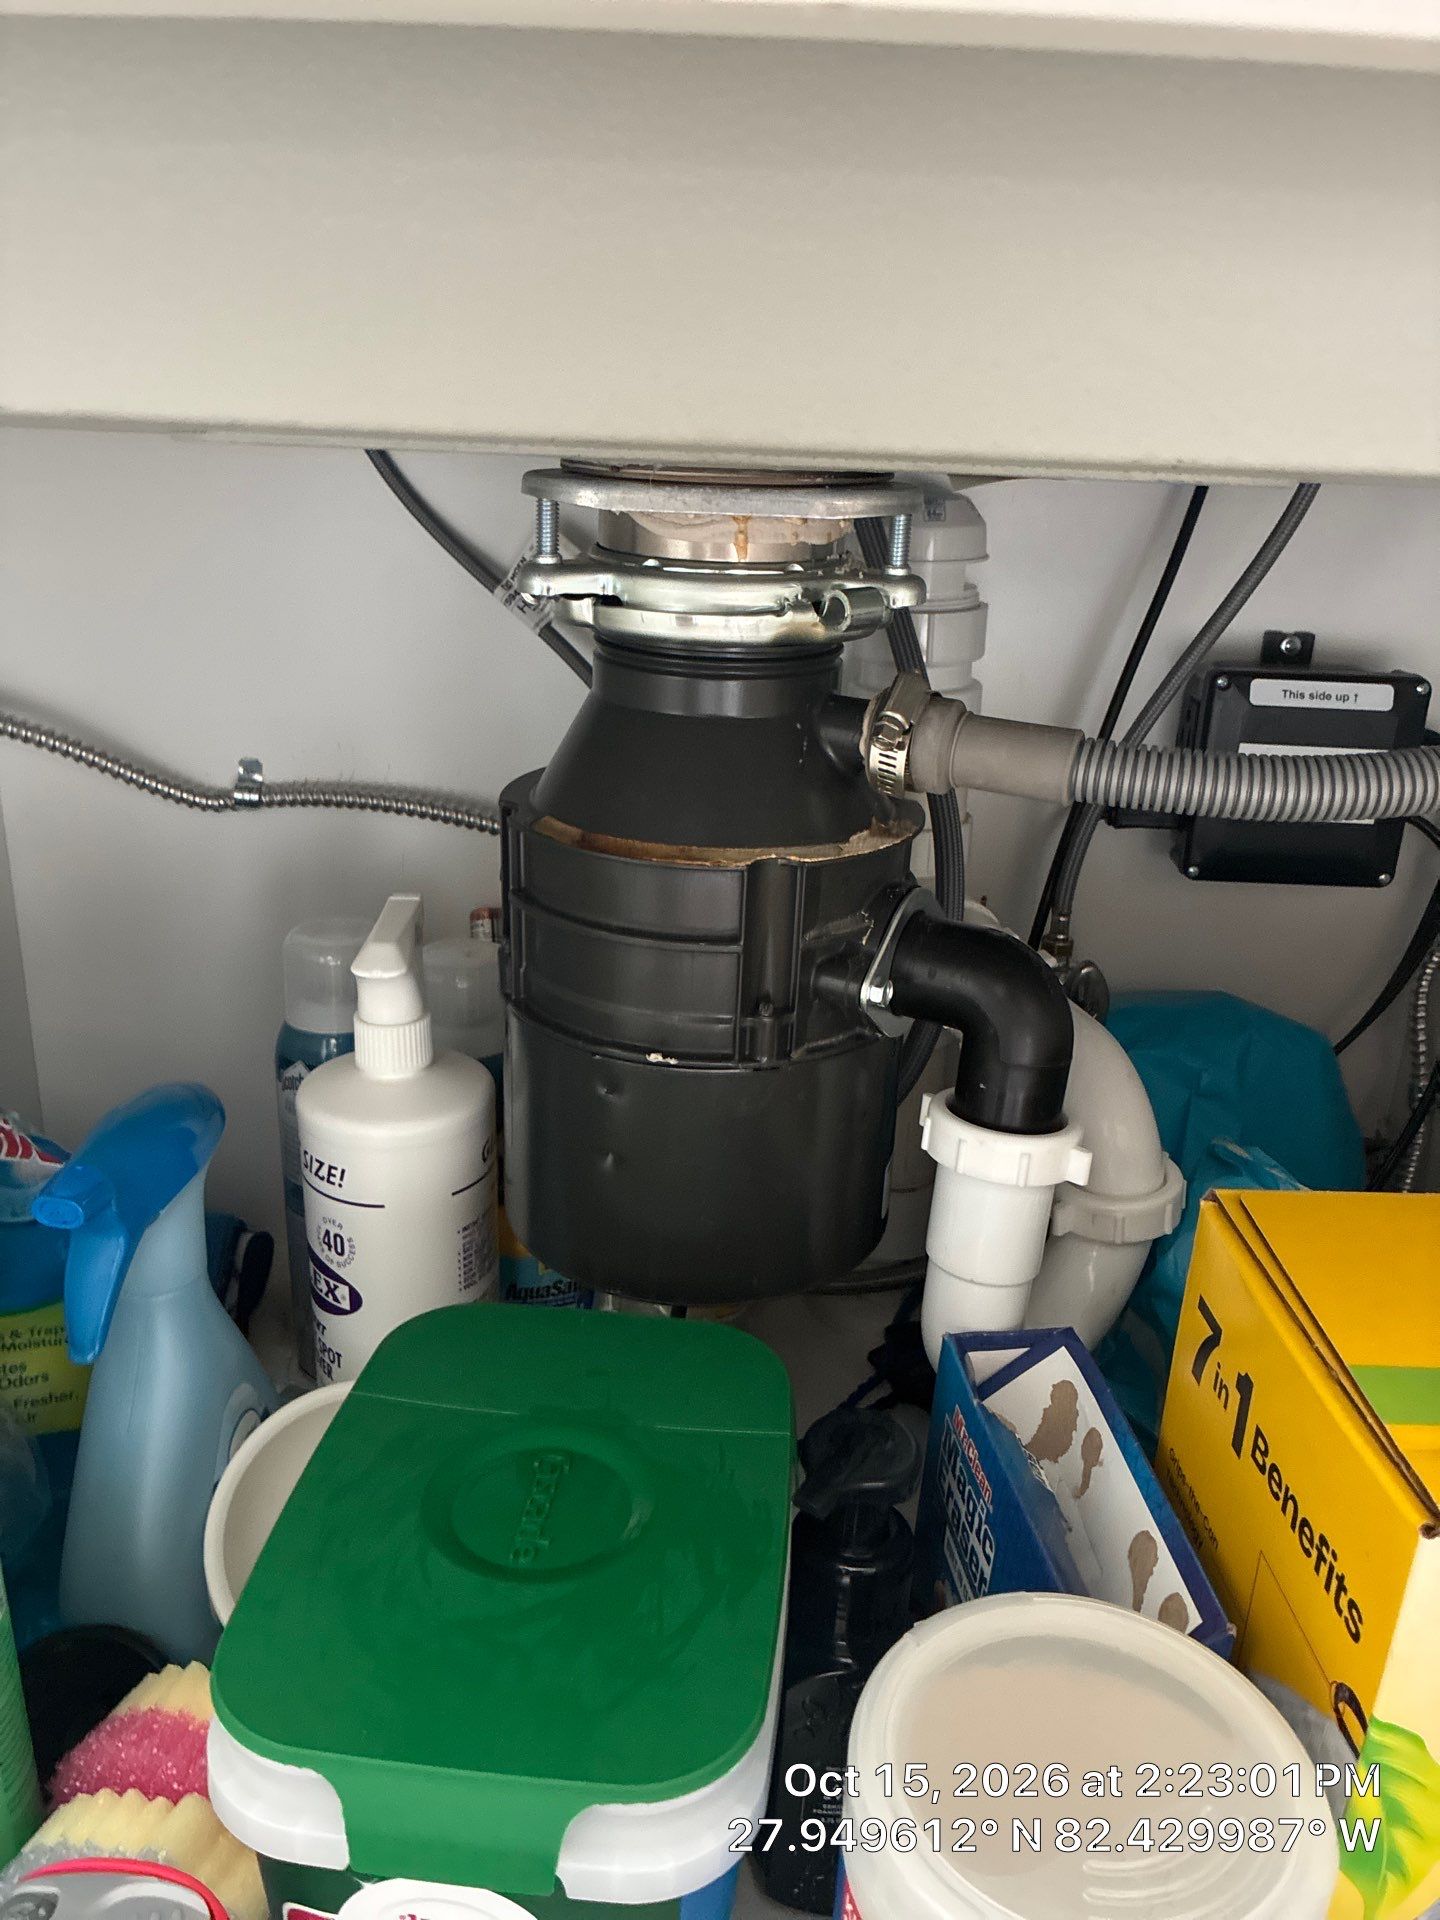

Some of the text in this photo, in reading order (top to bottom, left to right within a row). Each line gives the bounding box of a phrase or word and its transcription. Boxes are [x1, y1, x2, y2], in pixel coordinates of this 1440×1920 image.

[1282, 689, 1350, 704] This side up
[303, 1150, 346, 1188] SIZE!
[322, 1228, 346, 1257] 40
[1190, 1294, 1364, 1645] 7 in 1 Benefits
